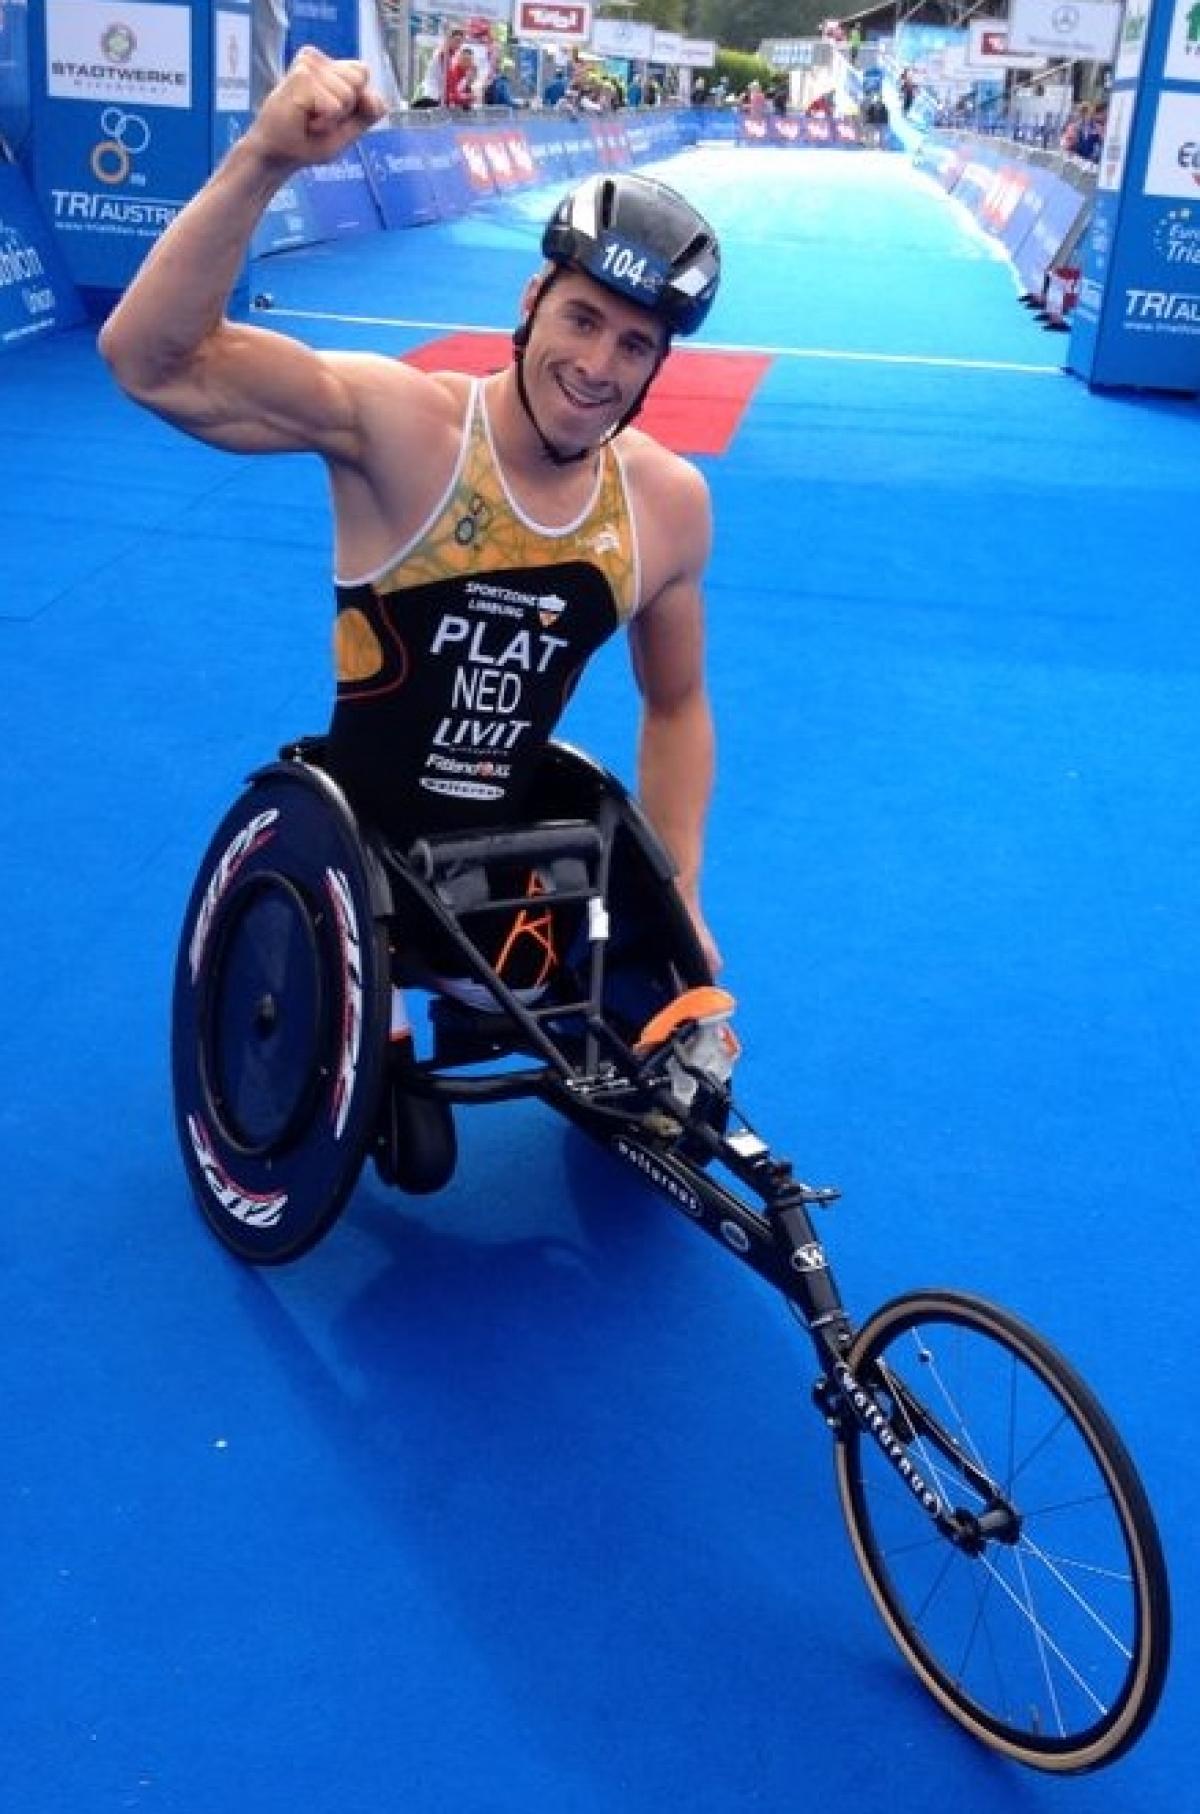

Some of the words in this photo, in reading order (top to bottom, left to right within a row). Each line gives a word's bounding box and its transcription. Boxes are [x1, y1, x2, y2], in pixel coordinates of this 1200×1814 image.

[51, 62, 186, 86] STADTWERKE
[52, 189, 98, 219] TRI
[99, 201, 178, 226] AUSTRI
[602, 243, 647, 286] 104
[1125, 290, 1176, 319] TRI
[430, 615, 569, 673] PLAT
[451, 665, 523, 714] NED
[432, 717, 532, 750] LIVIT
